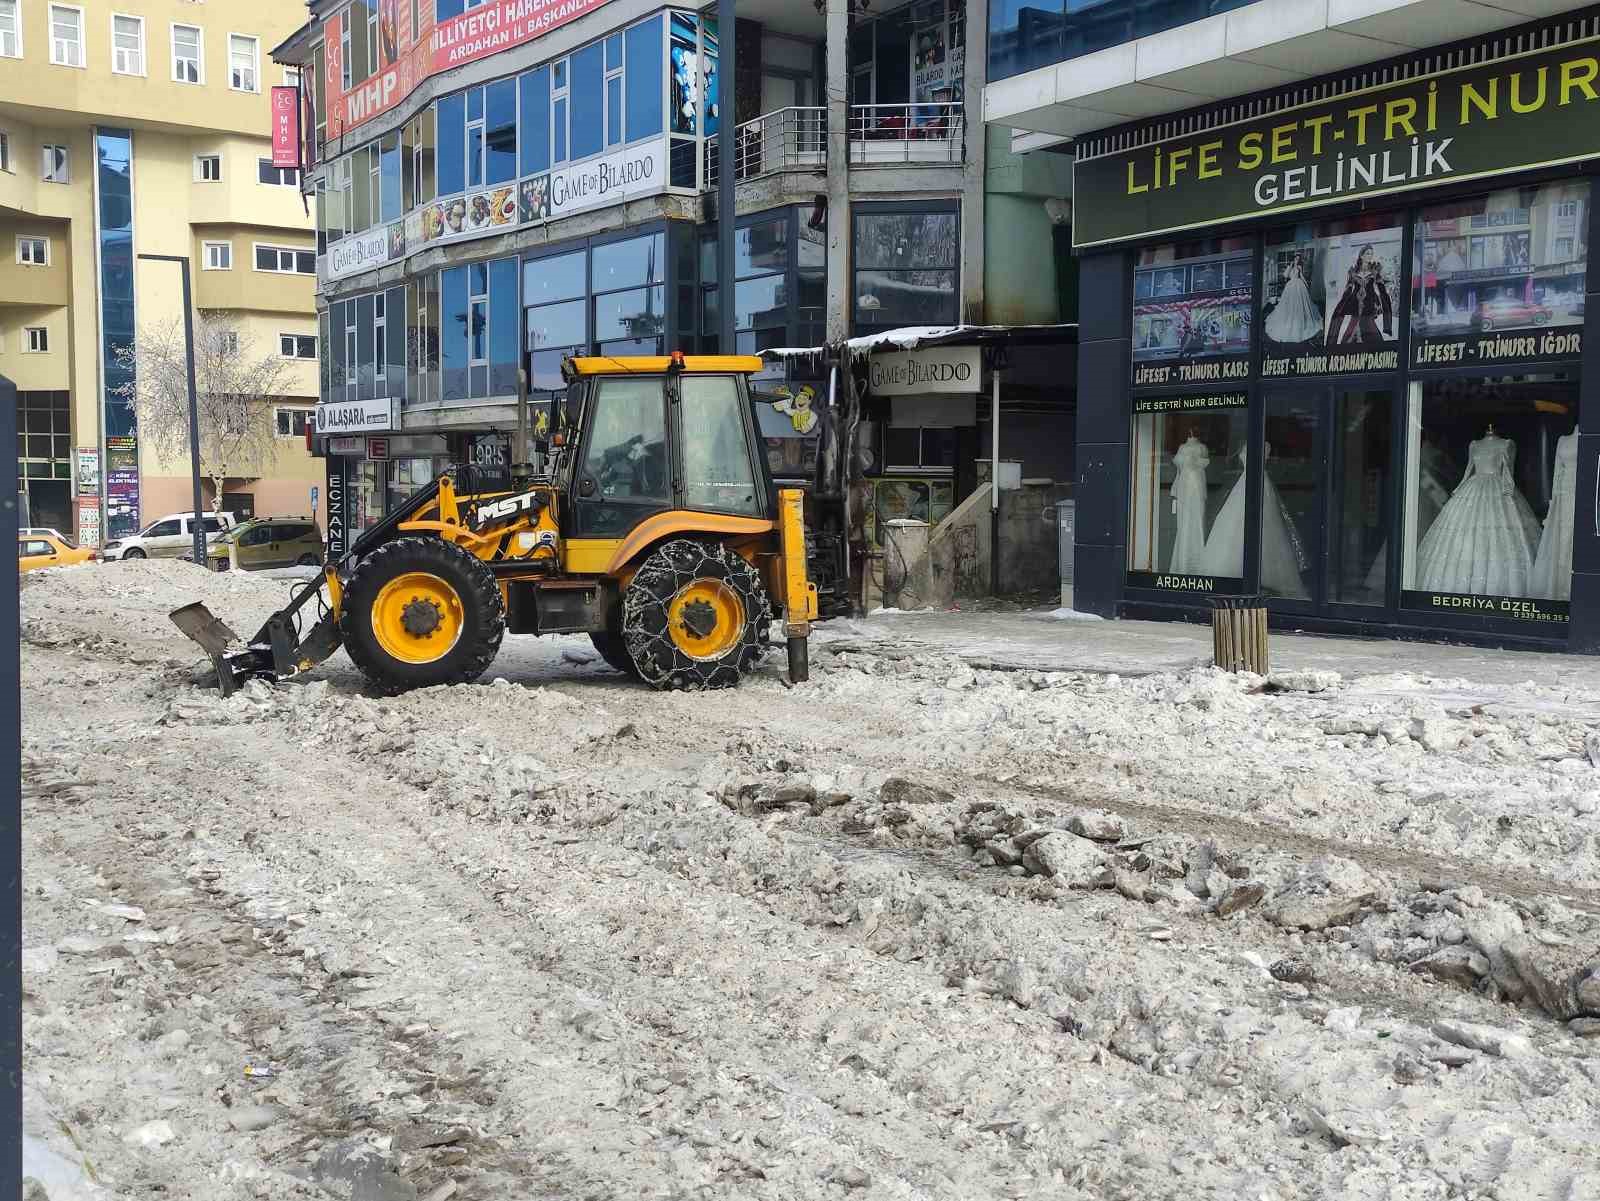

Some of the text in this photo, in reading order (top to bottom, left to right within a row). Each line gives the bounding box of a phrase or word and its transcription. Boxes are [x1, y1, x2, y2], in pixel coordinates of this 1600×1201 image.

[449, 30, 509, 63] ARDAHAN
[347, 71, 397, 125] MHP
[280, 115, 288, 144] MHP
[1127, 140, 1223, 195] LİFE
[1237, 80, 1437, 171] SET-TRİ
[1254, 136, 1454, 207] GELİNLİK
[552, 173, 588, 207] GAME
[589, 173, 598, 190] OF
[1416, 338, 1466, 364] LİFESET
[1477, 333, 1536, 359] TRİNURR
[1539, 331, 1581, 355] IĞDIR
[871, 361, 900, 388] GAME
[1135, 364, 1171, 385] LİFESET
[1179, 359, 1220, 382] TRİNURR
[1222, 361, 1249, 378] KARS
[1262, 352, 1290, 376] LİFESET
[1136, 399, 1151, 411] LİFE
[1183, 397, 1207, 409] NURR
[1207, 393, 1246, 406] GELİNLİK
[328, 407, 365, 429] ALAŞARA
[328, 476, 343, 553] ECZANE
[477, 490, 536, 523] MST
[1156, 575, 1214, 592] ARDAHAN
[1432, 594, 1540, 613] BEDRİYA ÖZEL
